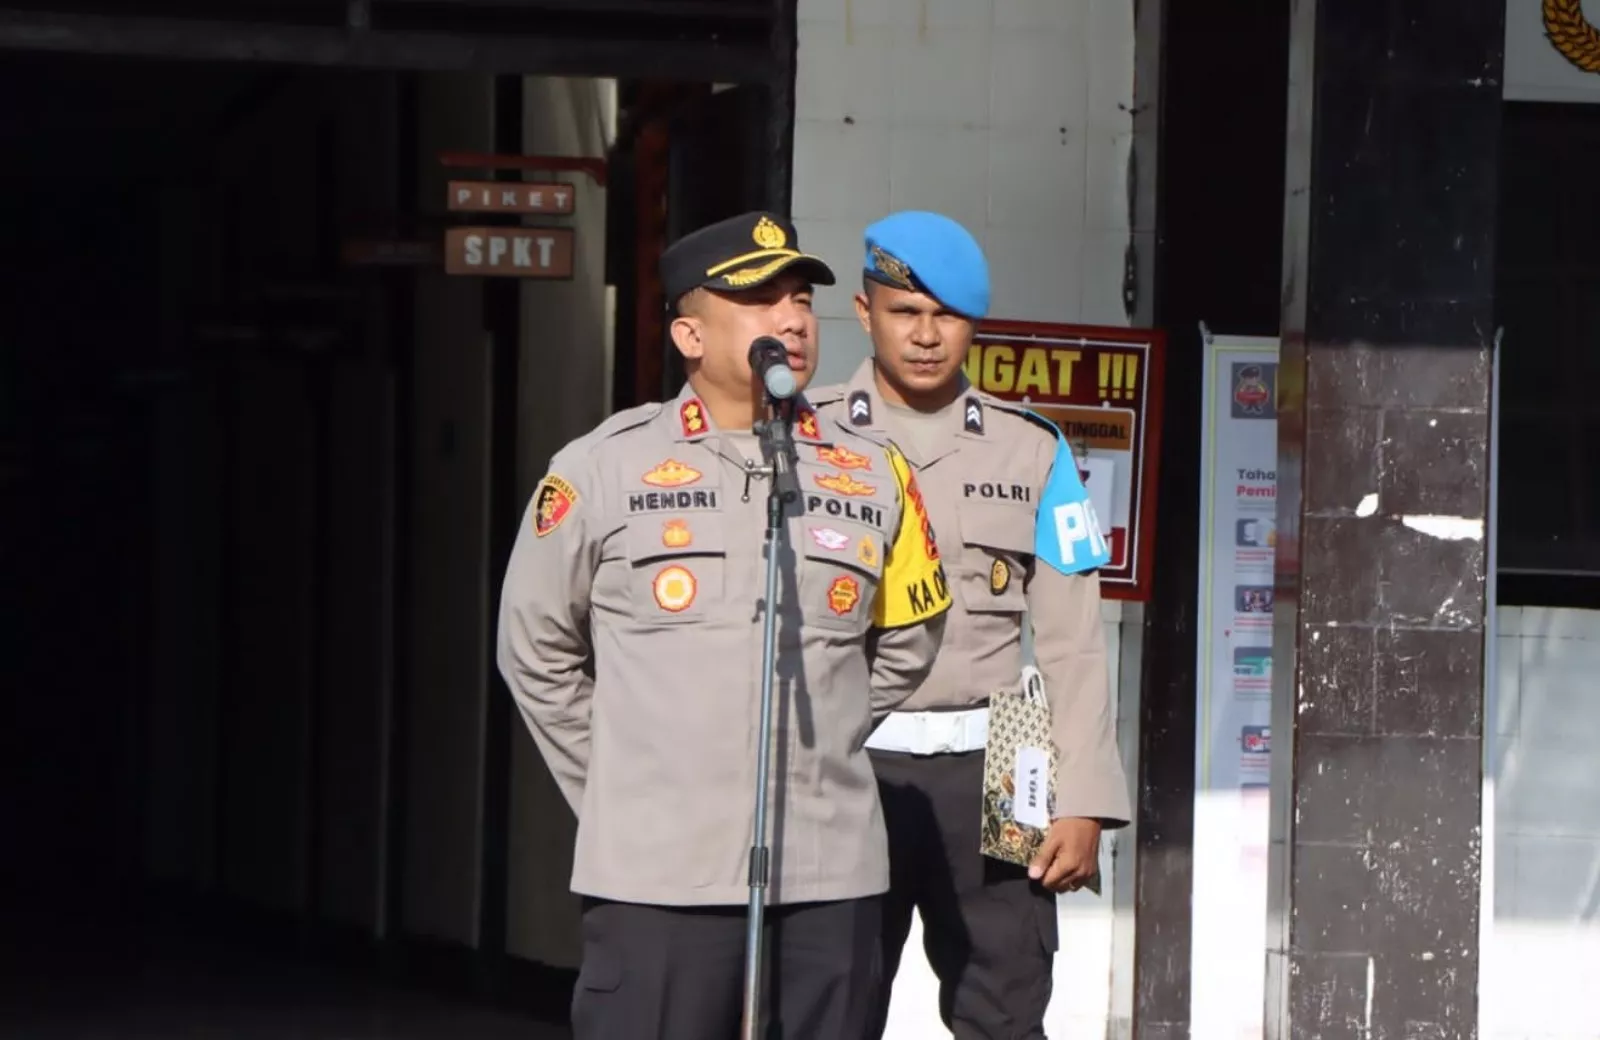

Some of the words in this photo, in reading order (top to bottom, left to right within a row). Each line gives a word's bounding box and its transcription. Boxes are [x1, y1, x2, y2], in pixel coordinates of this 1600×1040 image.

[457, 188, 568, 208] PIKET
[464, 235, 554, 268] SPKT
[1098, 352, 1138, 400] !!!
[1064, 421, 1128, 440] TINGGAL
[629, 491, 716, 512] HENDRI
[963, 483, 1030, 503] POLRI
[807, 496, 882, 528] POLRI
[907, 577, 936, 616] KA
